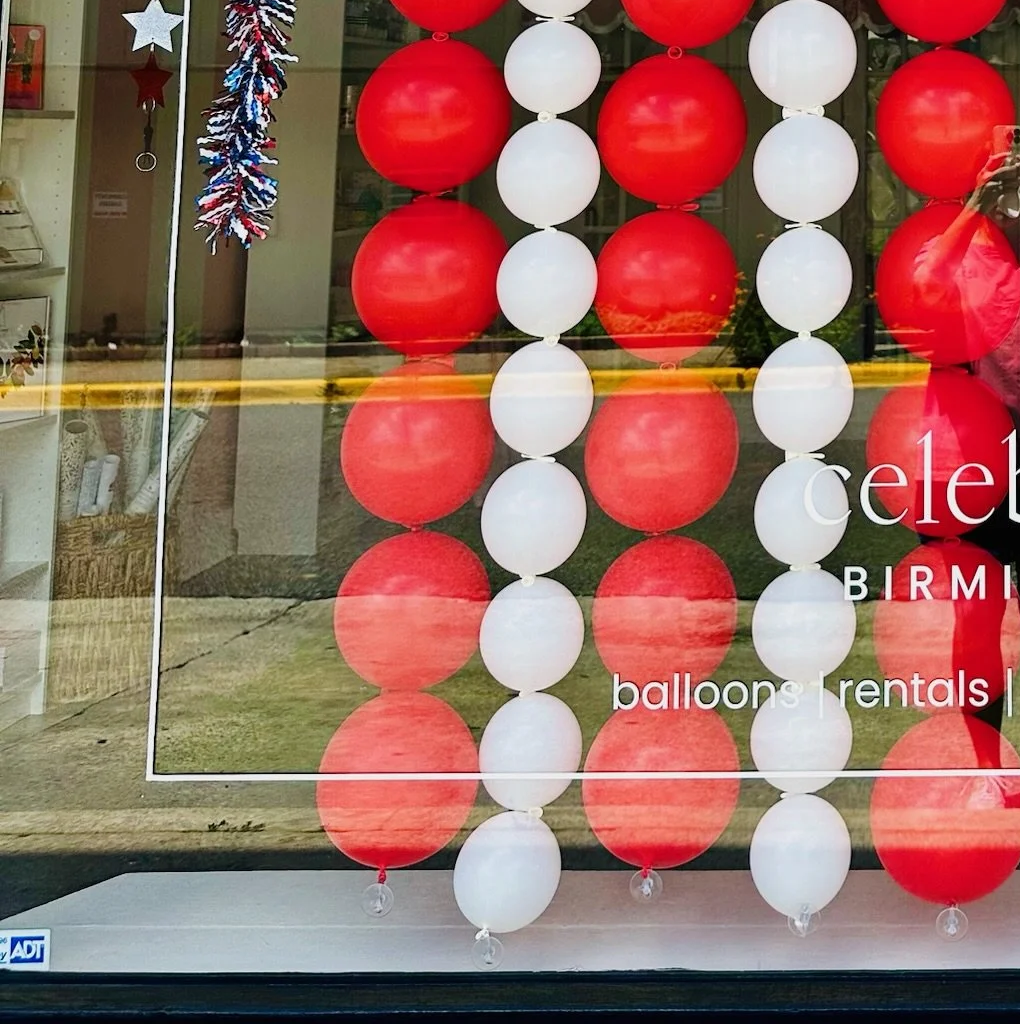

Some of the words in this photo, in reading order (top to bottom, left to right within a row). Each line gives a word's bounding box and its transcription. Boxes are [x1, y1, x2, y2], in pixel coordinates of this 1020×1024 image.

[612, 672, 804, 711] balloons
[838, 669, 990, 709] rentals
[10, 940, 45, 960] ADT
